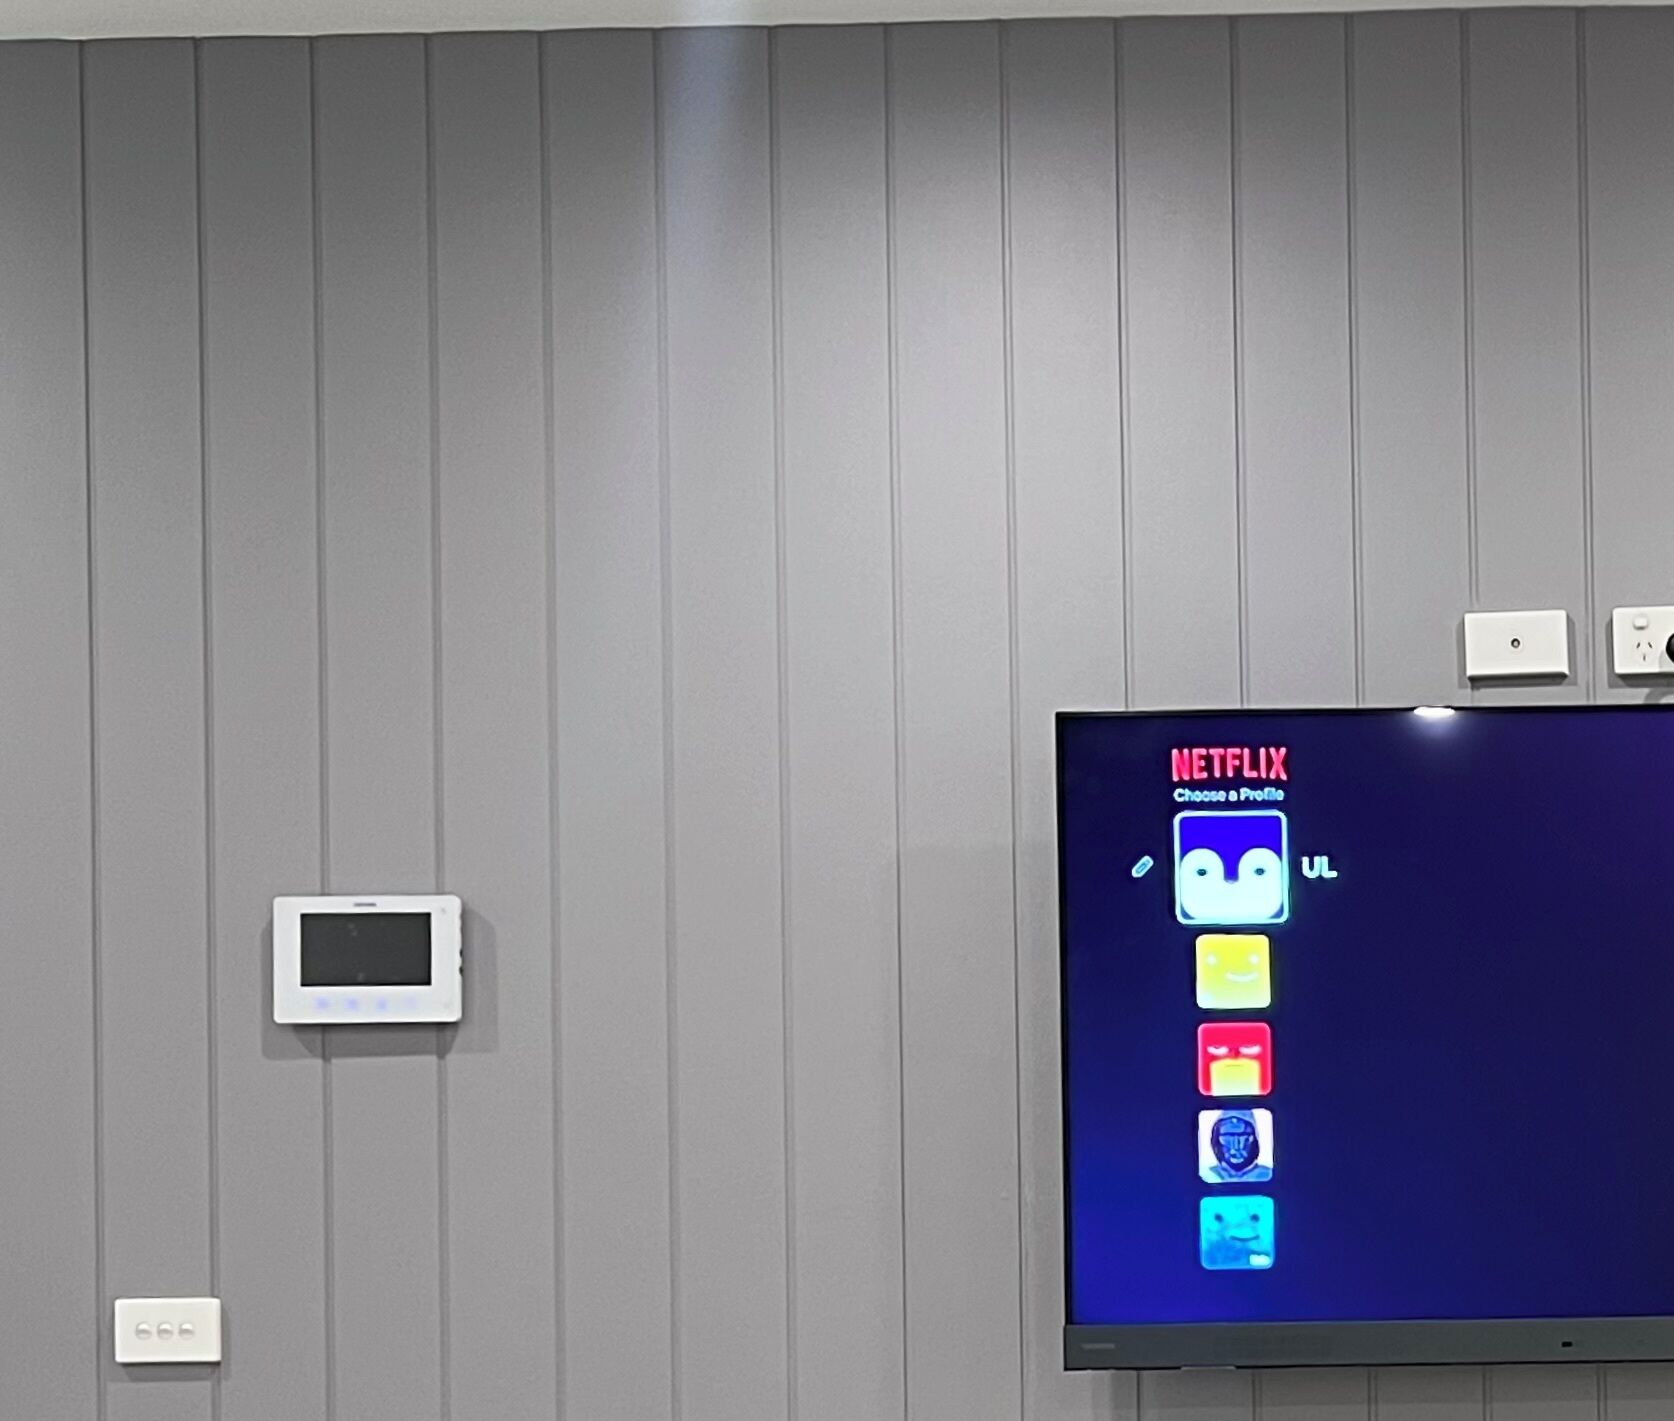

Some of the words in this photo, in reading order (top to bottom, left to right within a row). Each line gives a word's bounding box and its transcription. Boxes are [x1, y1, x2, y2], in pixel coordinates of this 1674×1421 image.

[1171, 747, 1288, 782] NETFLIX
[1173, 788, 1227, 802] Choose
[1228, 790, 1238, 801] a
[1240, 787, 1284, 801] Profile
[1301, 856, 1338, 878] UL
